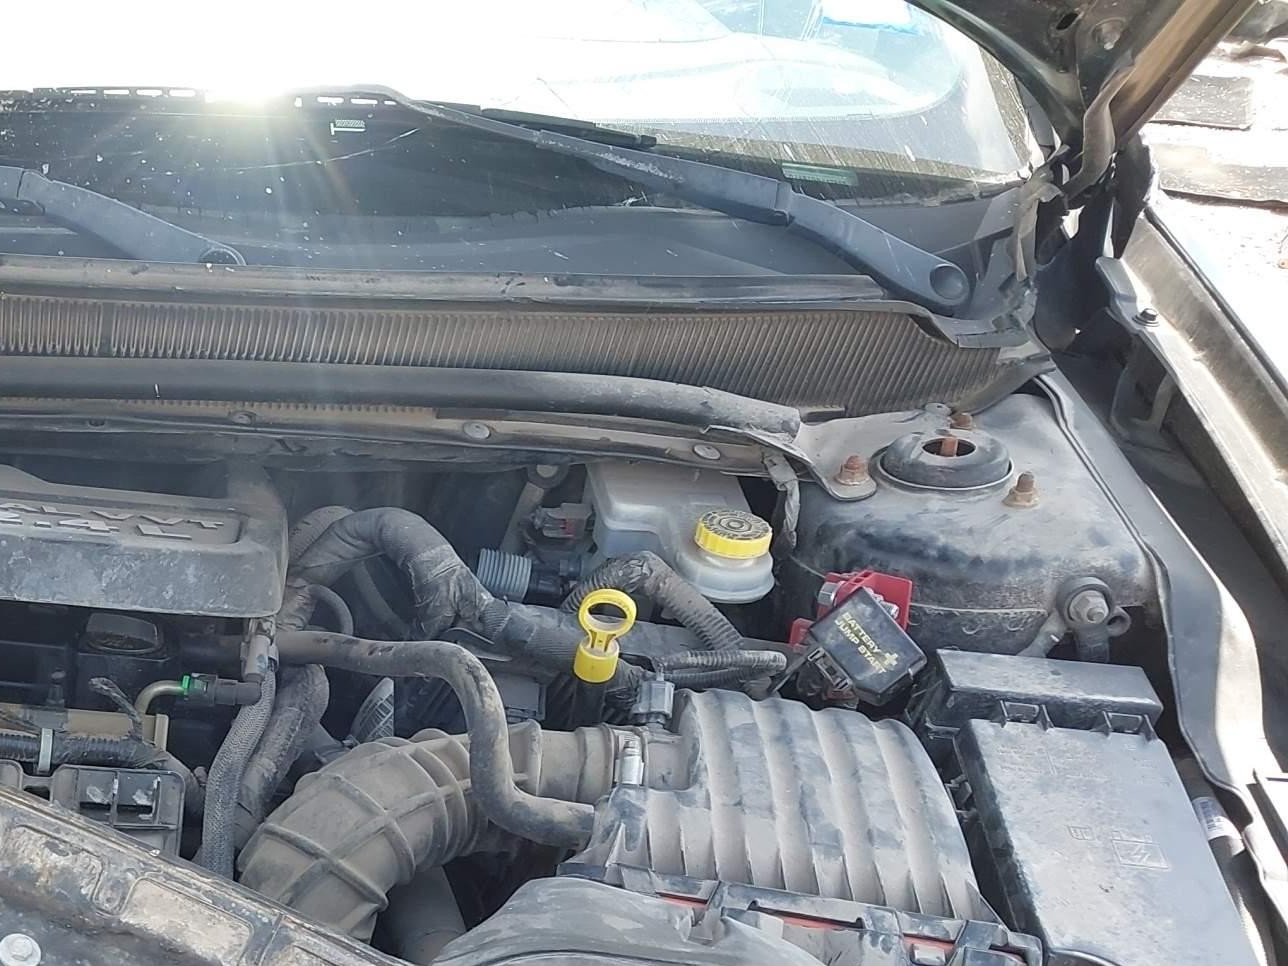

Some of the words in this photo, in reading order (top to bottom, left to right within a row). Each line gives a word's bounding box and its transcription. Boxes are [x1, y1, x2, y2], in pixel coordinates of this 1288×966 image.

[91, 509, 225, 530] VVT
[834, 618, 860, 645] JUMP
[857, 645, 887, 674] START
[841, 612, 882, 654] BATTERY
